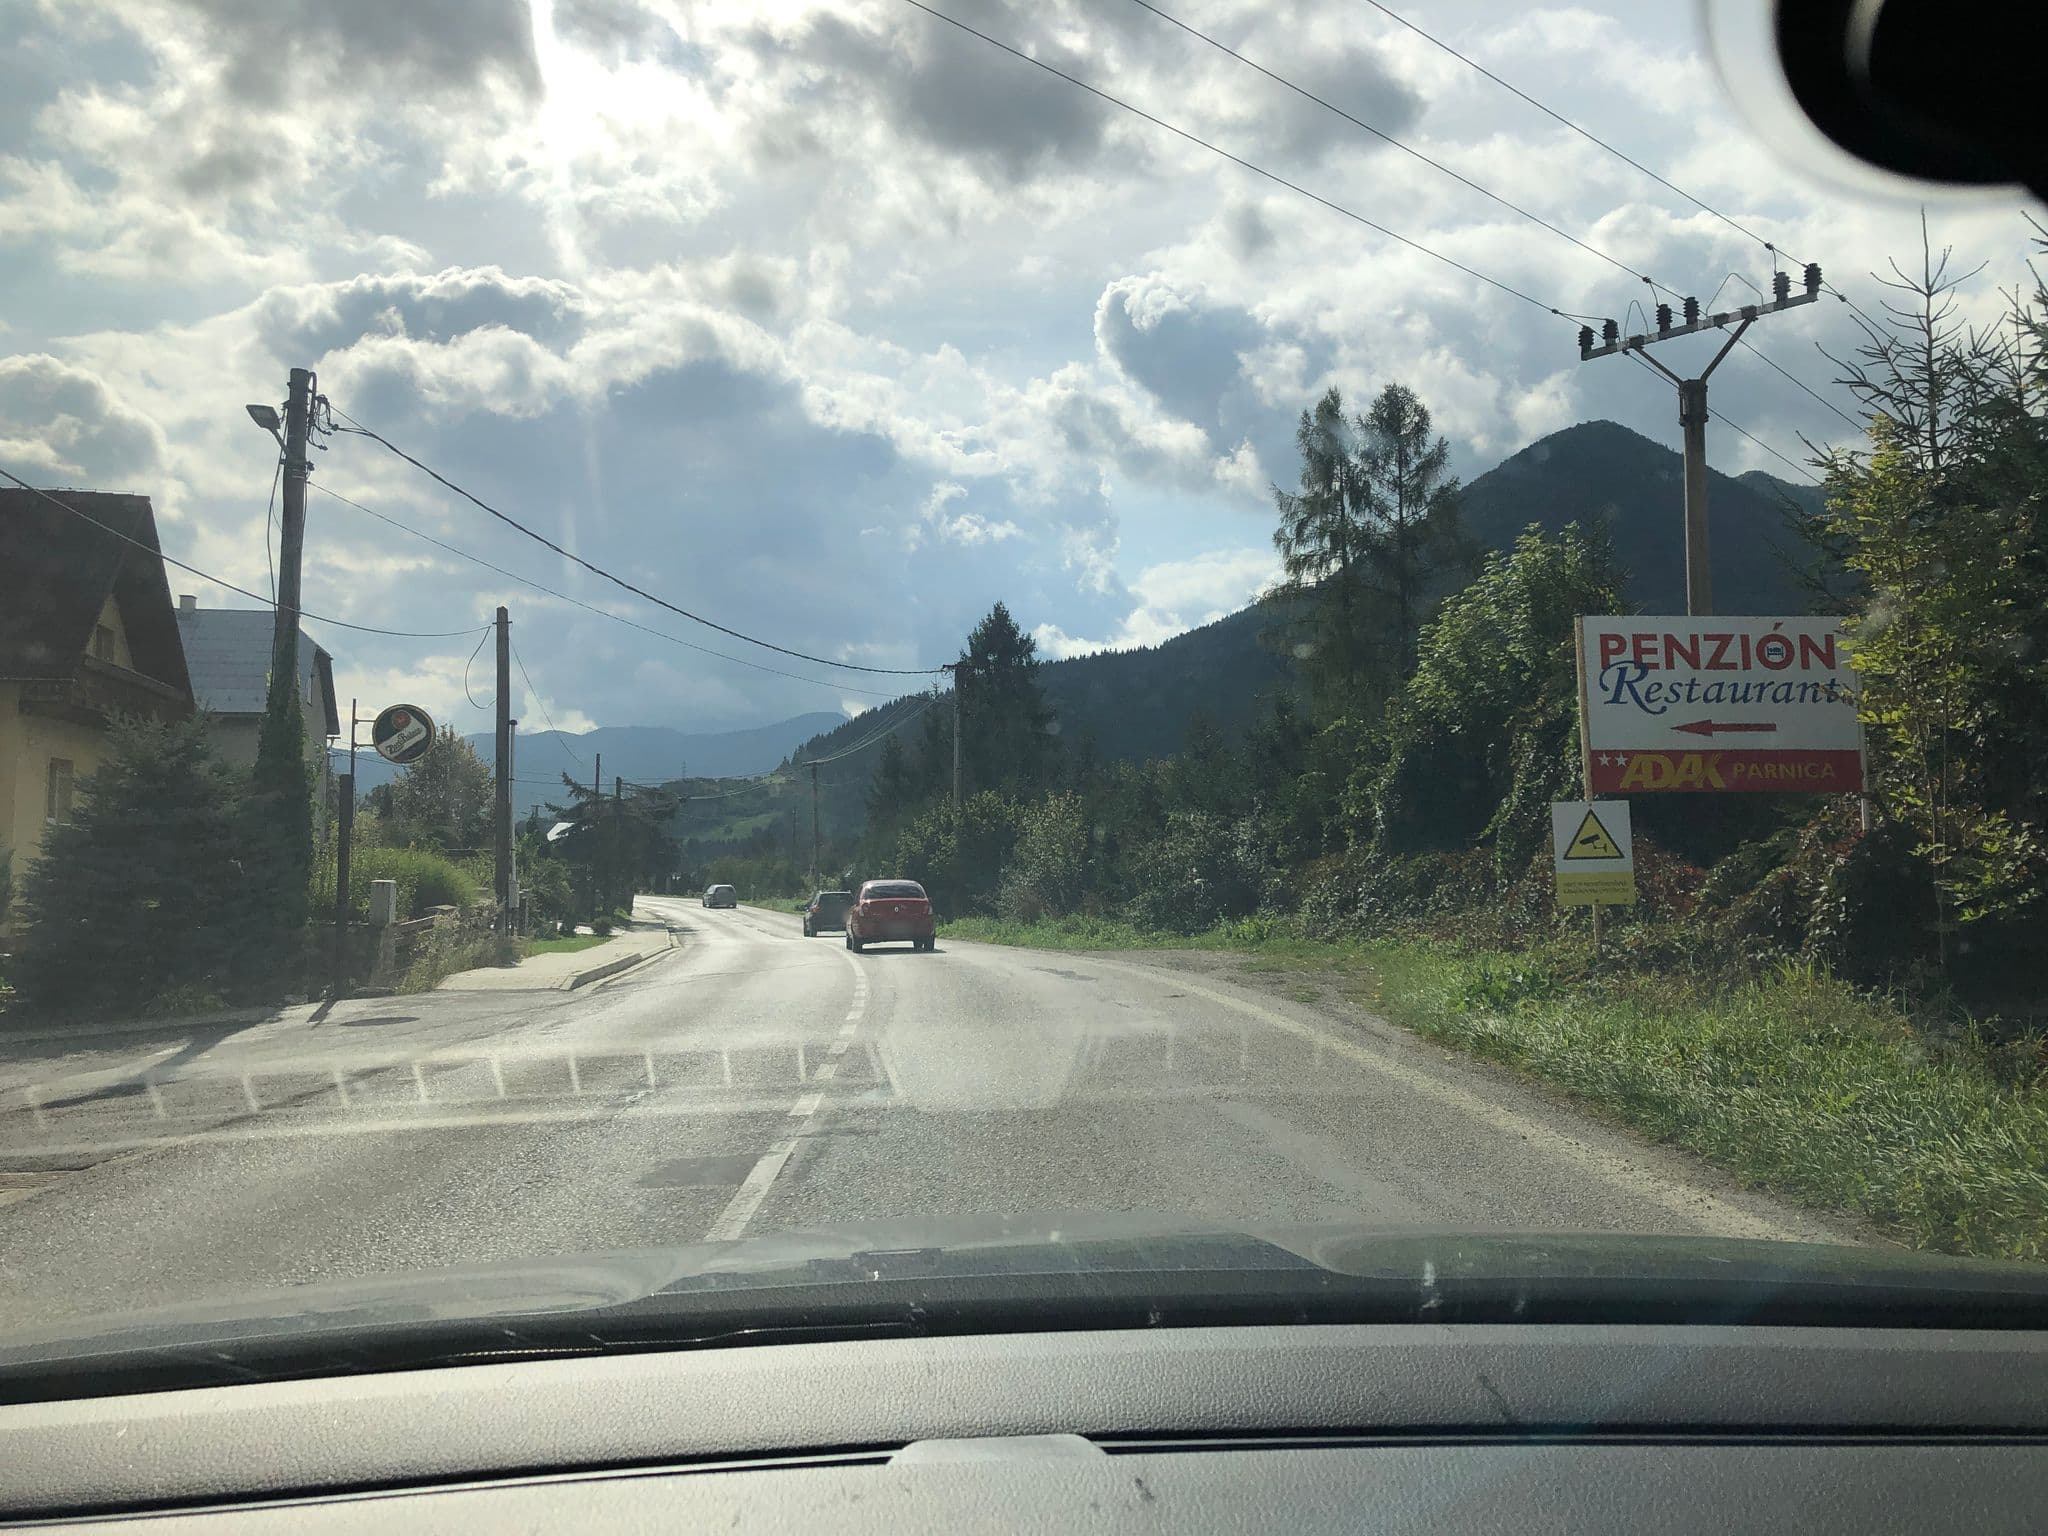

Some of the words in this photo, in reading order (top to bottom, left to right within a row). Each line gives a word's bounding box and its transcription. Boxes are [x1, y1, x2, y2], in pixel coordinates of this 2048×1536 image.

[1599, 622, 1836, 671] PENZIÓN
[1599, 660, 1841, 714] Restaurant
[1618, 753, 1727, 789] ADAK
